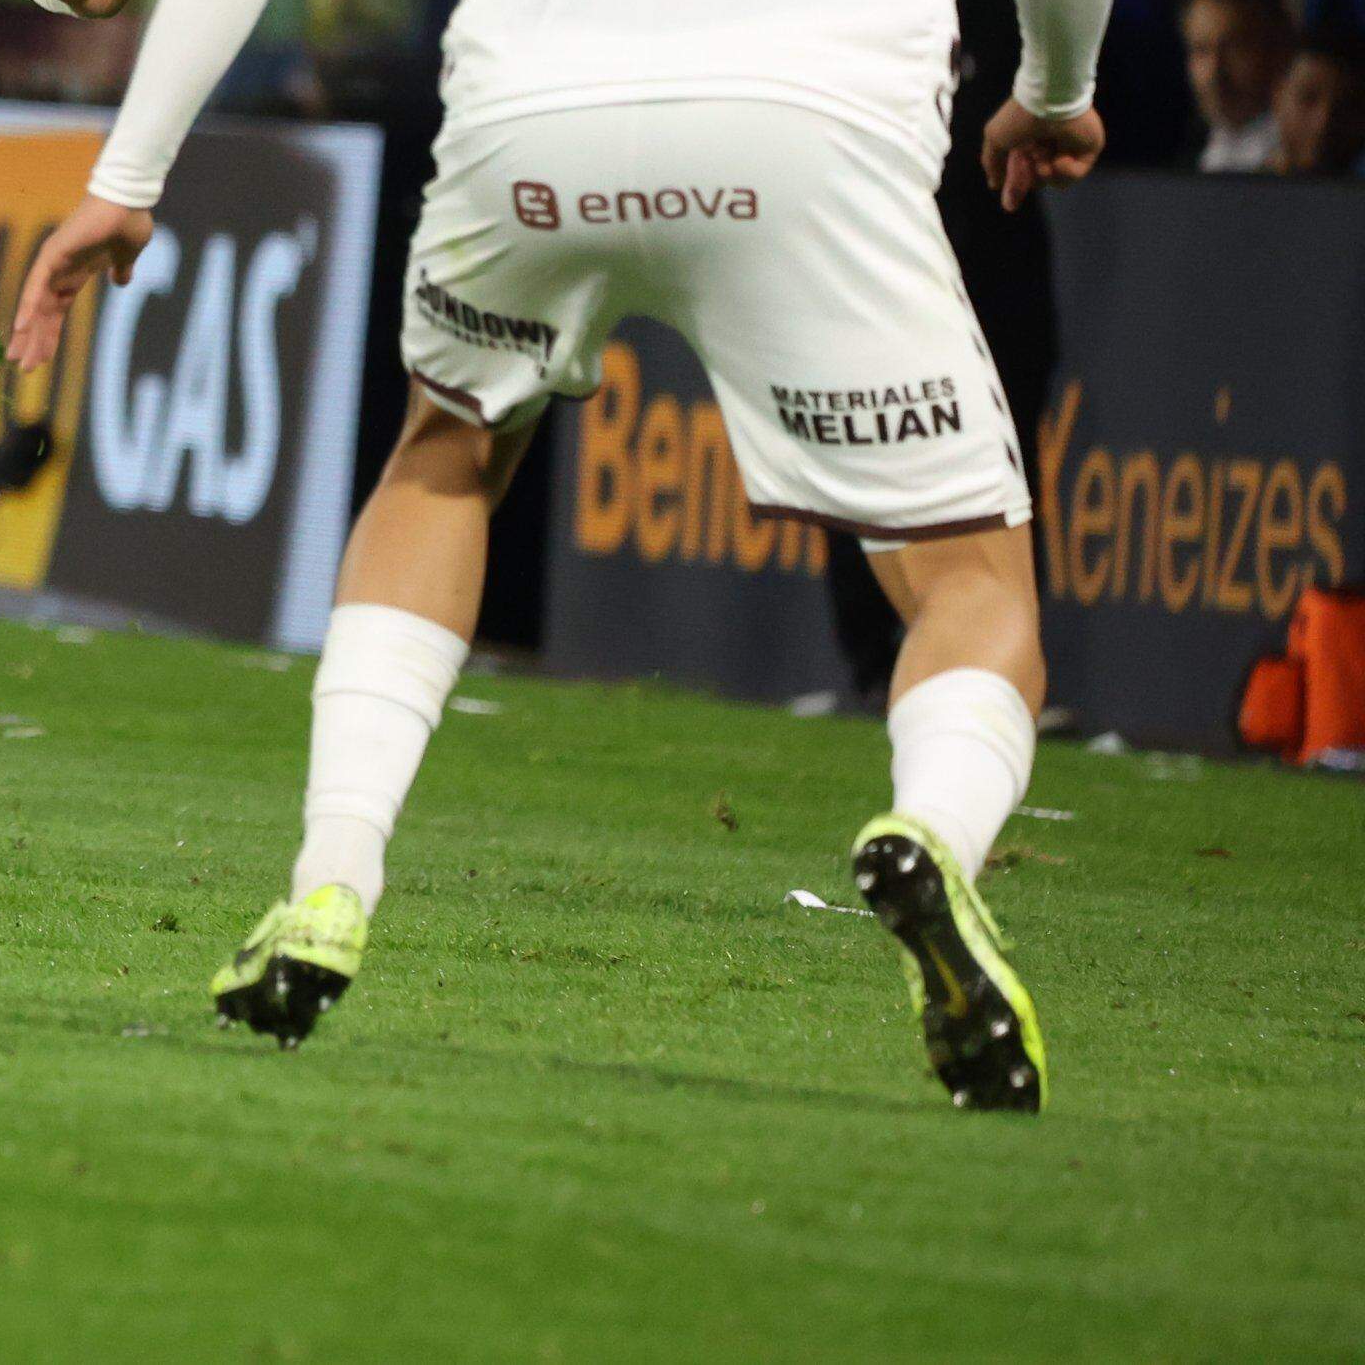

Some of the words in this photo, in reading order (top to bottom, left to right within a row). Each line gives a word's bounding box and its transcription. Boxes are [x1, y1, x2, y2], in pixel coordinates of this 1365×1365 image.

[578, 187, 759, 224] enova
[91, 222, 304, 526] GAS
[770, 377, 956, 411] MATERIALES
[779, 400, 962, 445] MELIAN
[1036, 378, 1347, 622] Xeneizes
